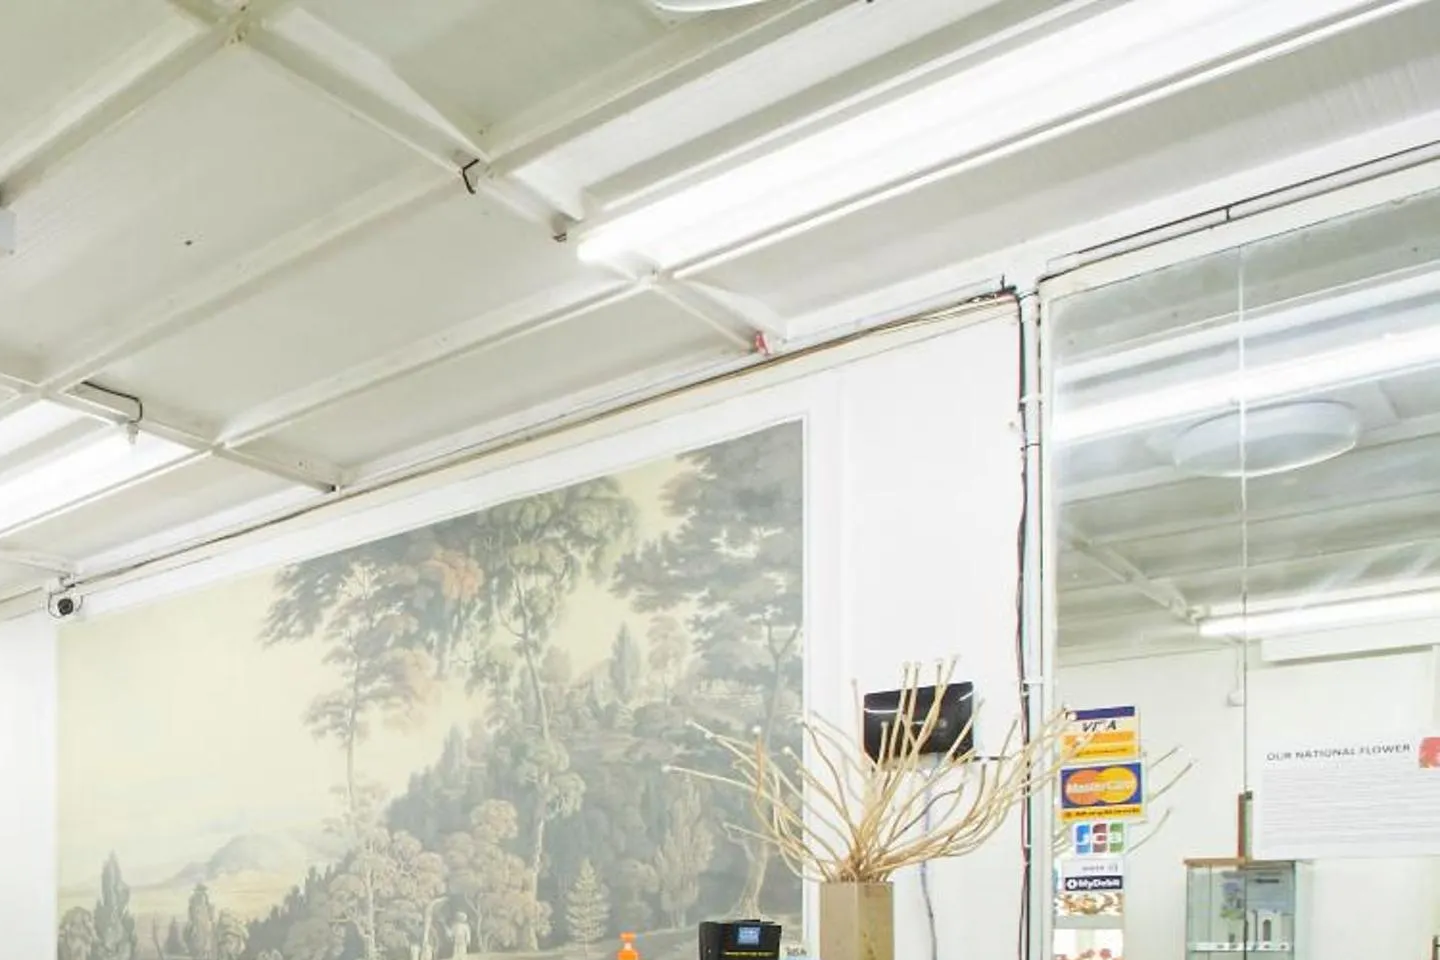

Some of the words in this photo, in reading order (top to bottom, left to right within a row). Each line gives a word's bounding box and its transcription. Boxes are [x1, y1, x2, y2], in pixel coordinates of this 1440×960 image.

[1266, 752, 1291, 761] OUR
[1296, 748, 1356, 758] NATIONAL
[1360, 743, 1410, 755] FLOWER
[1074, 830, 1123, 847] JCB
